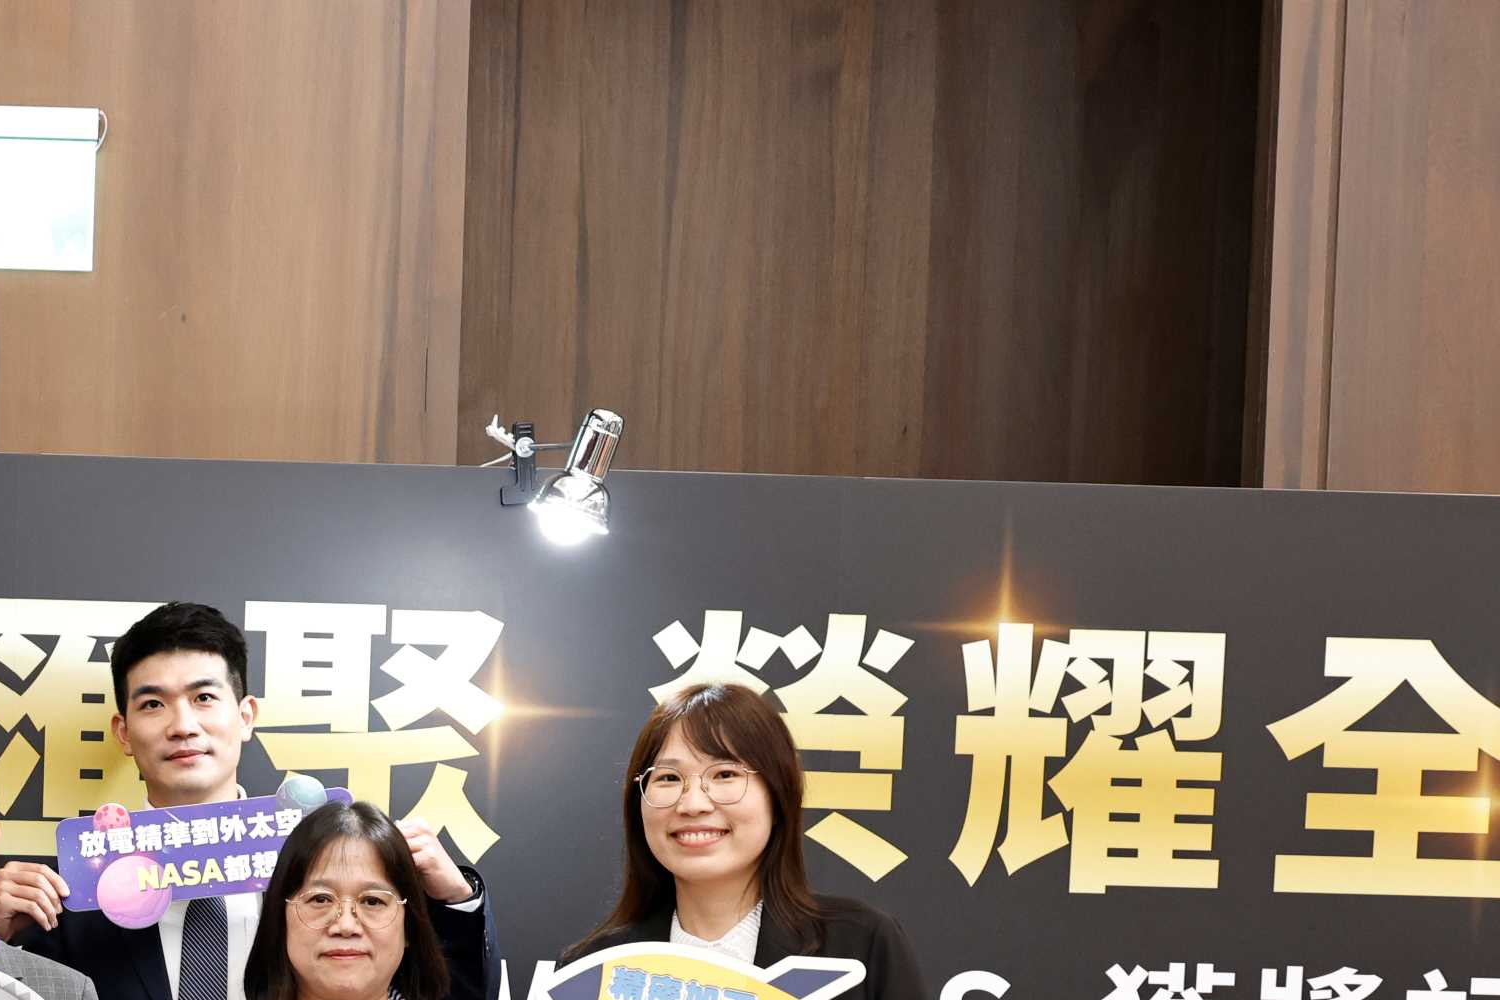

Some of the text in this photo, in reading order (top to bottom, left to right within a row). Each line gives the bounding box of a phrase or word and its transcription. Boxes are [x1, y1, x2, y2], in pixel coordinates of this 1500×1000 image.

[79, 808, 302, 858] 放電精準到外太空
